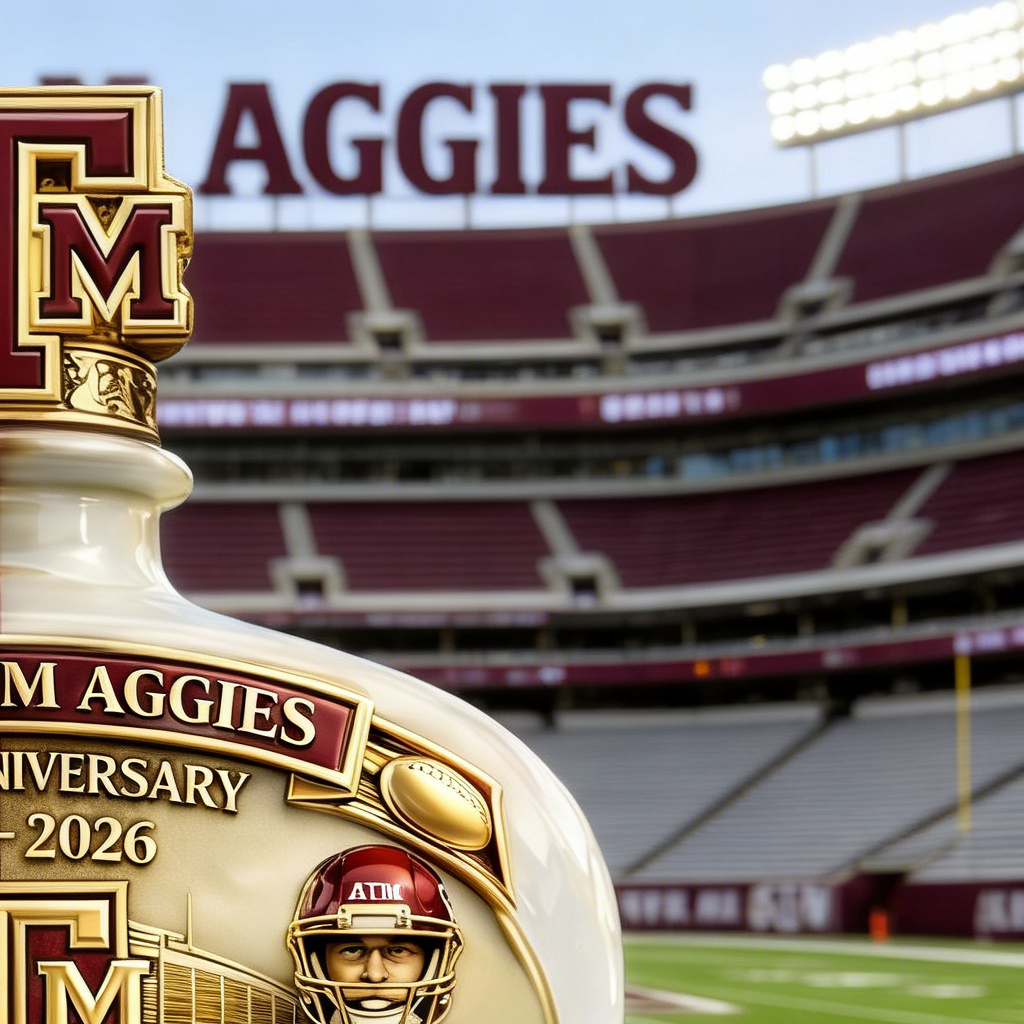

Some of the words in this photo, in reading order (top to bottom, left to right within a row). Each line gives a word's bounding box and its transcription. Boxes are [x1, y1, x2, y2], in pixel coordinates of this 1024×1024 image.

[201, 82, 698, 197] AGGIES
[77, 664, 318, 748] AGGIES
[25, 814, 158, 866] 2026
